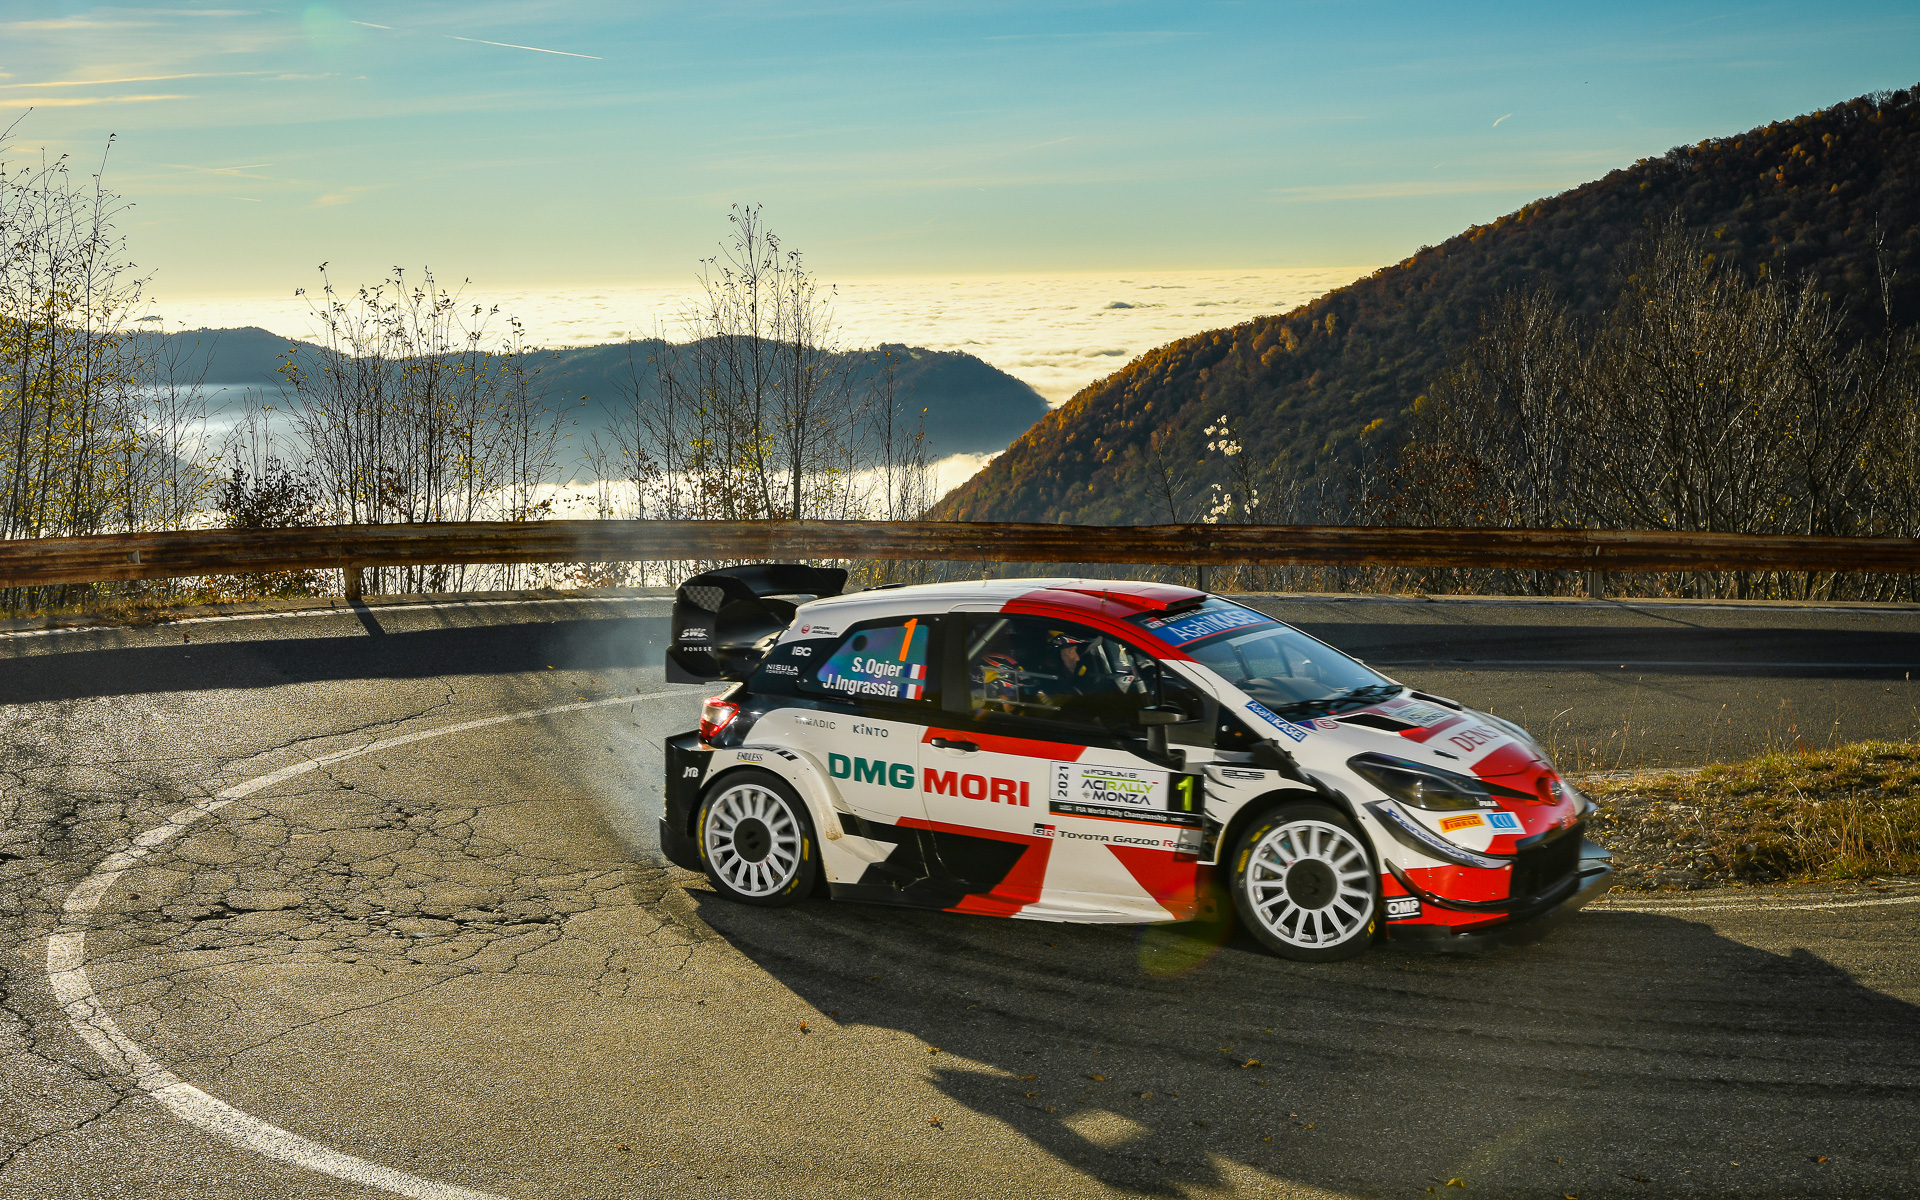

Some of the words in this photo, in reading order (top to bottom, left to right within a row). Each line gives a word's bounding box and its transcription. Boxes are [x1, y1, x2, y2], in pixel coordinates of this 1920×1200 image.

[898, 618, 918, 662] 1
[766, 663, 799, 673] NISULA
[851, 656, 903, 679] S.Ogier
[822, 673, 899, 697] J.Ingrassia
[1448, 725, 1501, 752] DENS
[736, 751, 764, 763] ENDLESS
[682, 766, 699, 779] JTB
[828, 752, 915, 790] DMG
[923, 767, 1030, 807] MORI
[1058, 766, 1069, 797] 2021
[1092, 790, 1151, 805] MONZA
[1176, 775, 1194, 812] 1
[1087, 807, 1106, 815] World
[1106, 809, 1123, 818] Rally
[1440, 815, 1481, 831] PIRELLI
[1035, 827, 1055, 838] GR
[1058, 830, 1110, 842] TOYOTA
[1112, 835, 1160, 847] GAZOO
[1387, 900, 1420, 915] OMP
